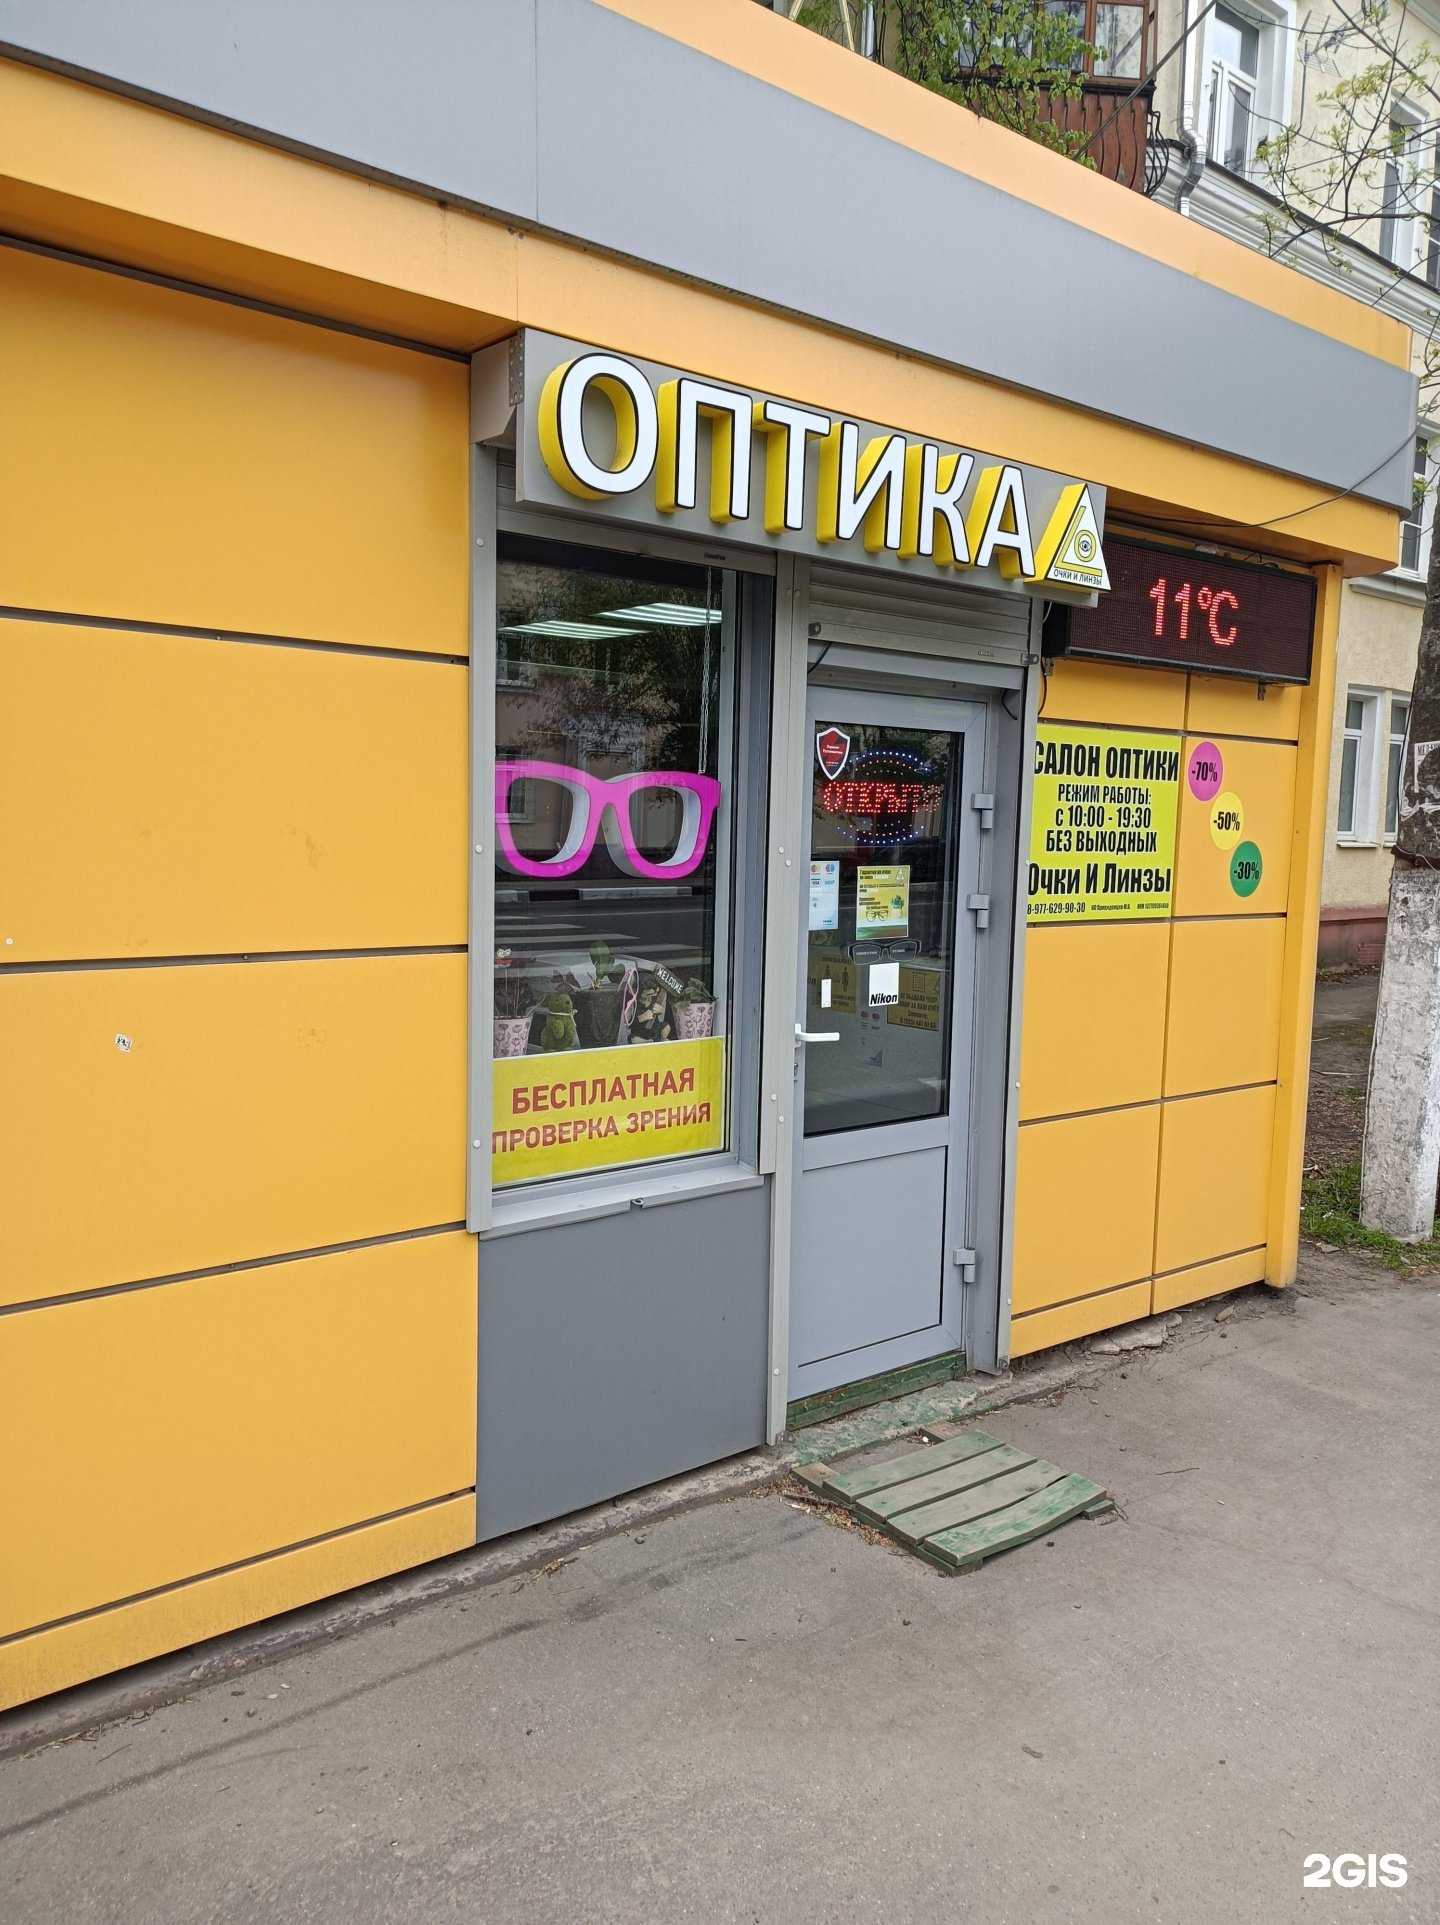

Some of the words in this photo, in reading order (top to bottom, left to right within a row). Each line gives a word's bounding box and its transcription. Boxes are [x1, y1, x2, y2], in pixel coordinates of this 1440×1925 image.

[555, 351, 1036, 577] ОПТИКА
[1053, 568, 1072, 580] ОЧКИ
[1079, 573, 1102, 586] ЛИНЗЫ
[1034, 740, 1100, 777] САЛОН
[1105, 746, 1180, 782] ОПТИКИ
[1191, 761, 1218, 783] -70%
[1057, 783, 1100, 803] РЕЖИМ
[1103, 785, 1152, 805] РАБОТЫ:
[1068, 805, 1105, 828] 10:00
[1116, 806, 1152, 829] 19:30
[1213, 810, 1241, 832] -50%
[1046, 829, 1073, 852] БЕЗ
[1075, 830, 1157, 855] ВЫХОДНЫХ
[1027, 863, 1081, 896] Очки
[1085, 863, 1099, 894] И
[1102, 862, 1172, 894] Линзы
[1233, 860, 1260, 880] -30%
[869, 992, 898, 1006] Nikon
[511, 1067, 696, 1115] БЕСПЛАТНАЯ
[491, 1115, 620, 1155] ПРОВЕРКА
[626, 1102, 712, 1134] ЗРЕНИЯ
